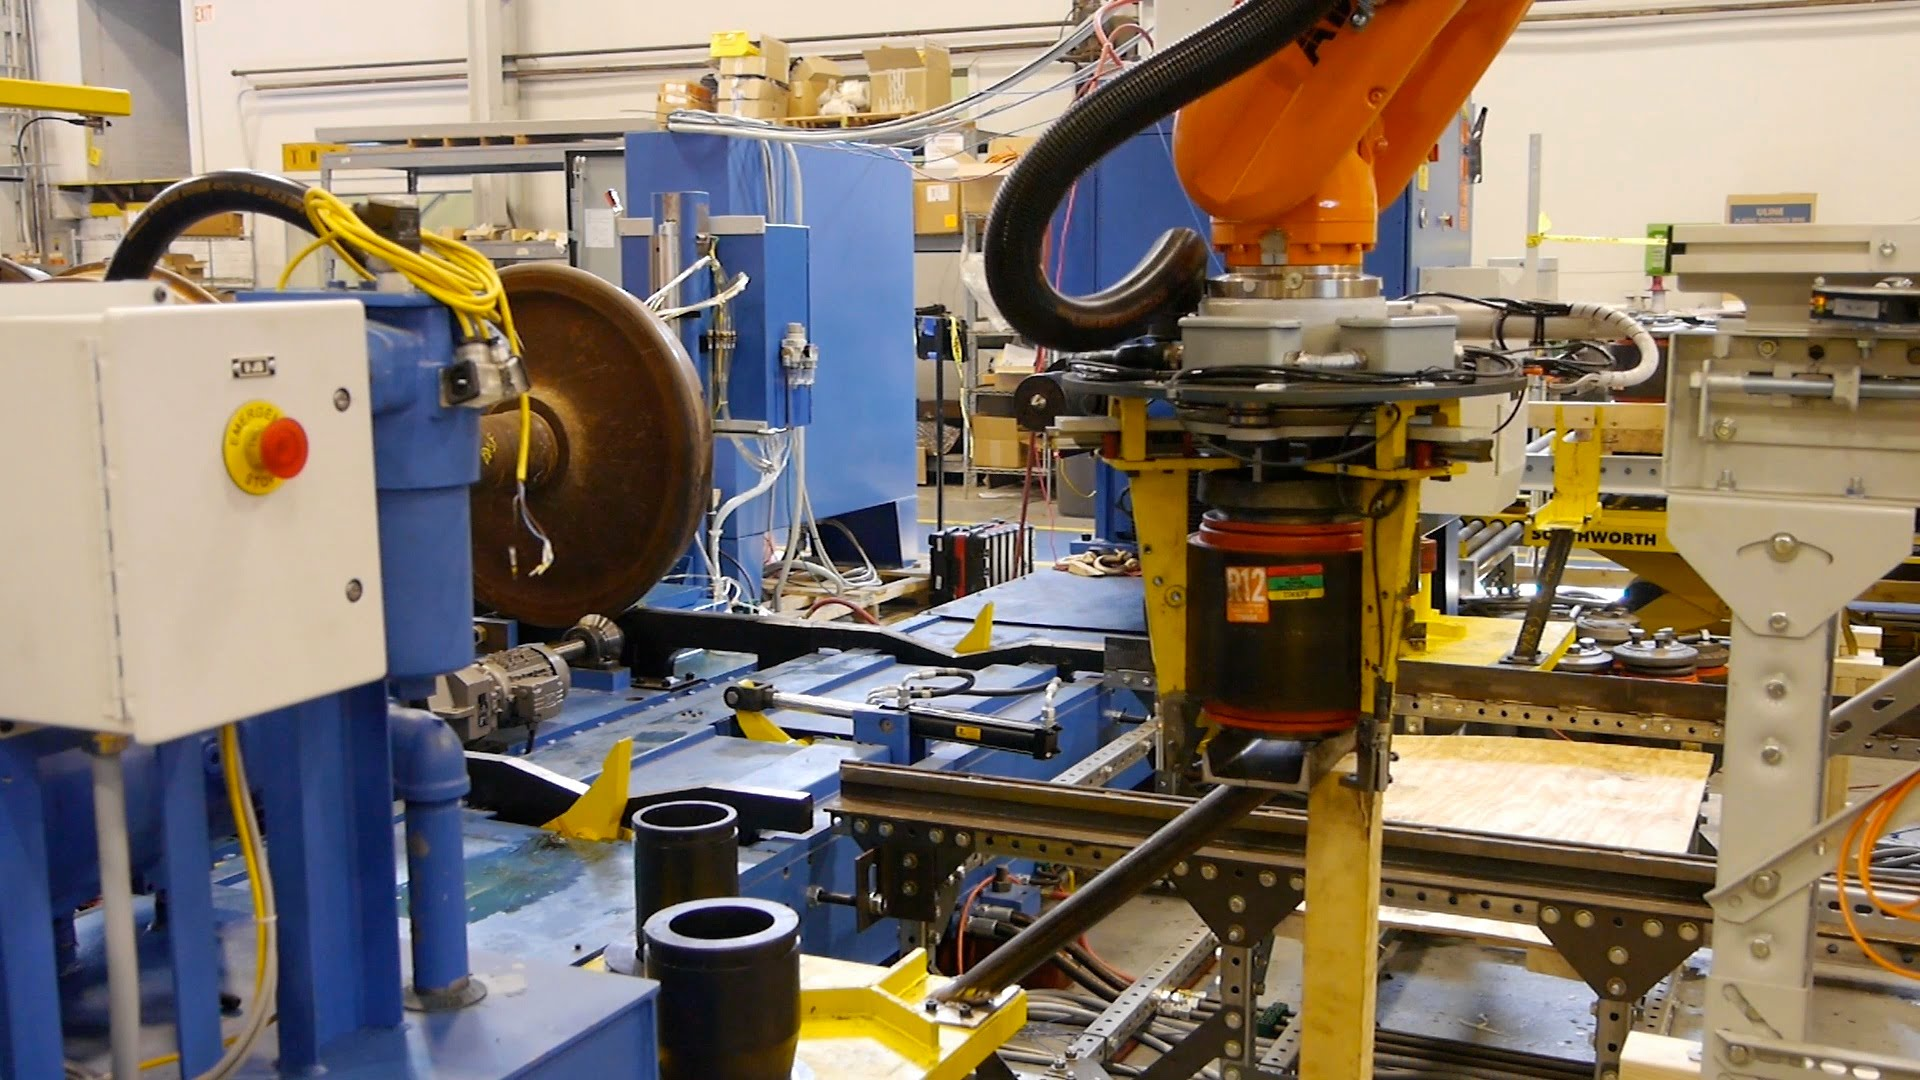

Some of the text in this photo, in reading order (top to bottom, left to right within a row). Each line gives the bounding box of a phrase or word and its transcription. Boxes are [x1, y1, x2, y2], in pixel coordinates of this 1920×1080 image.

[229, 406, 280, 447] EMERGE
[1532, 529, 1656, 546] SOHWORTH
[1226, 566, 1268, 602] R12
